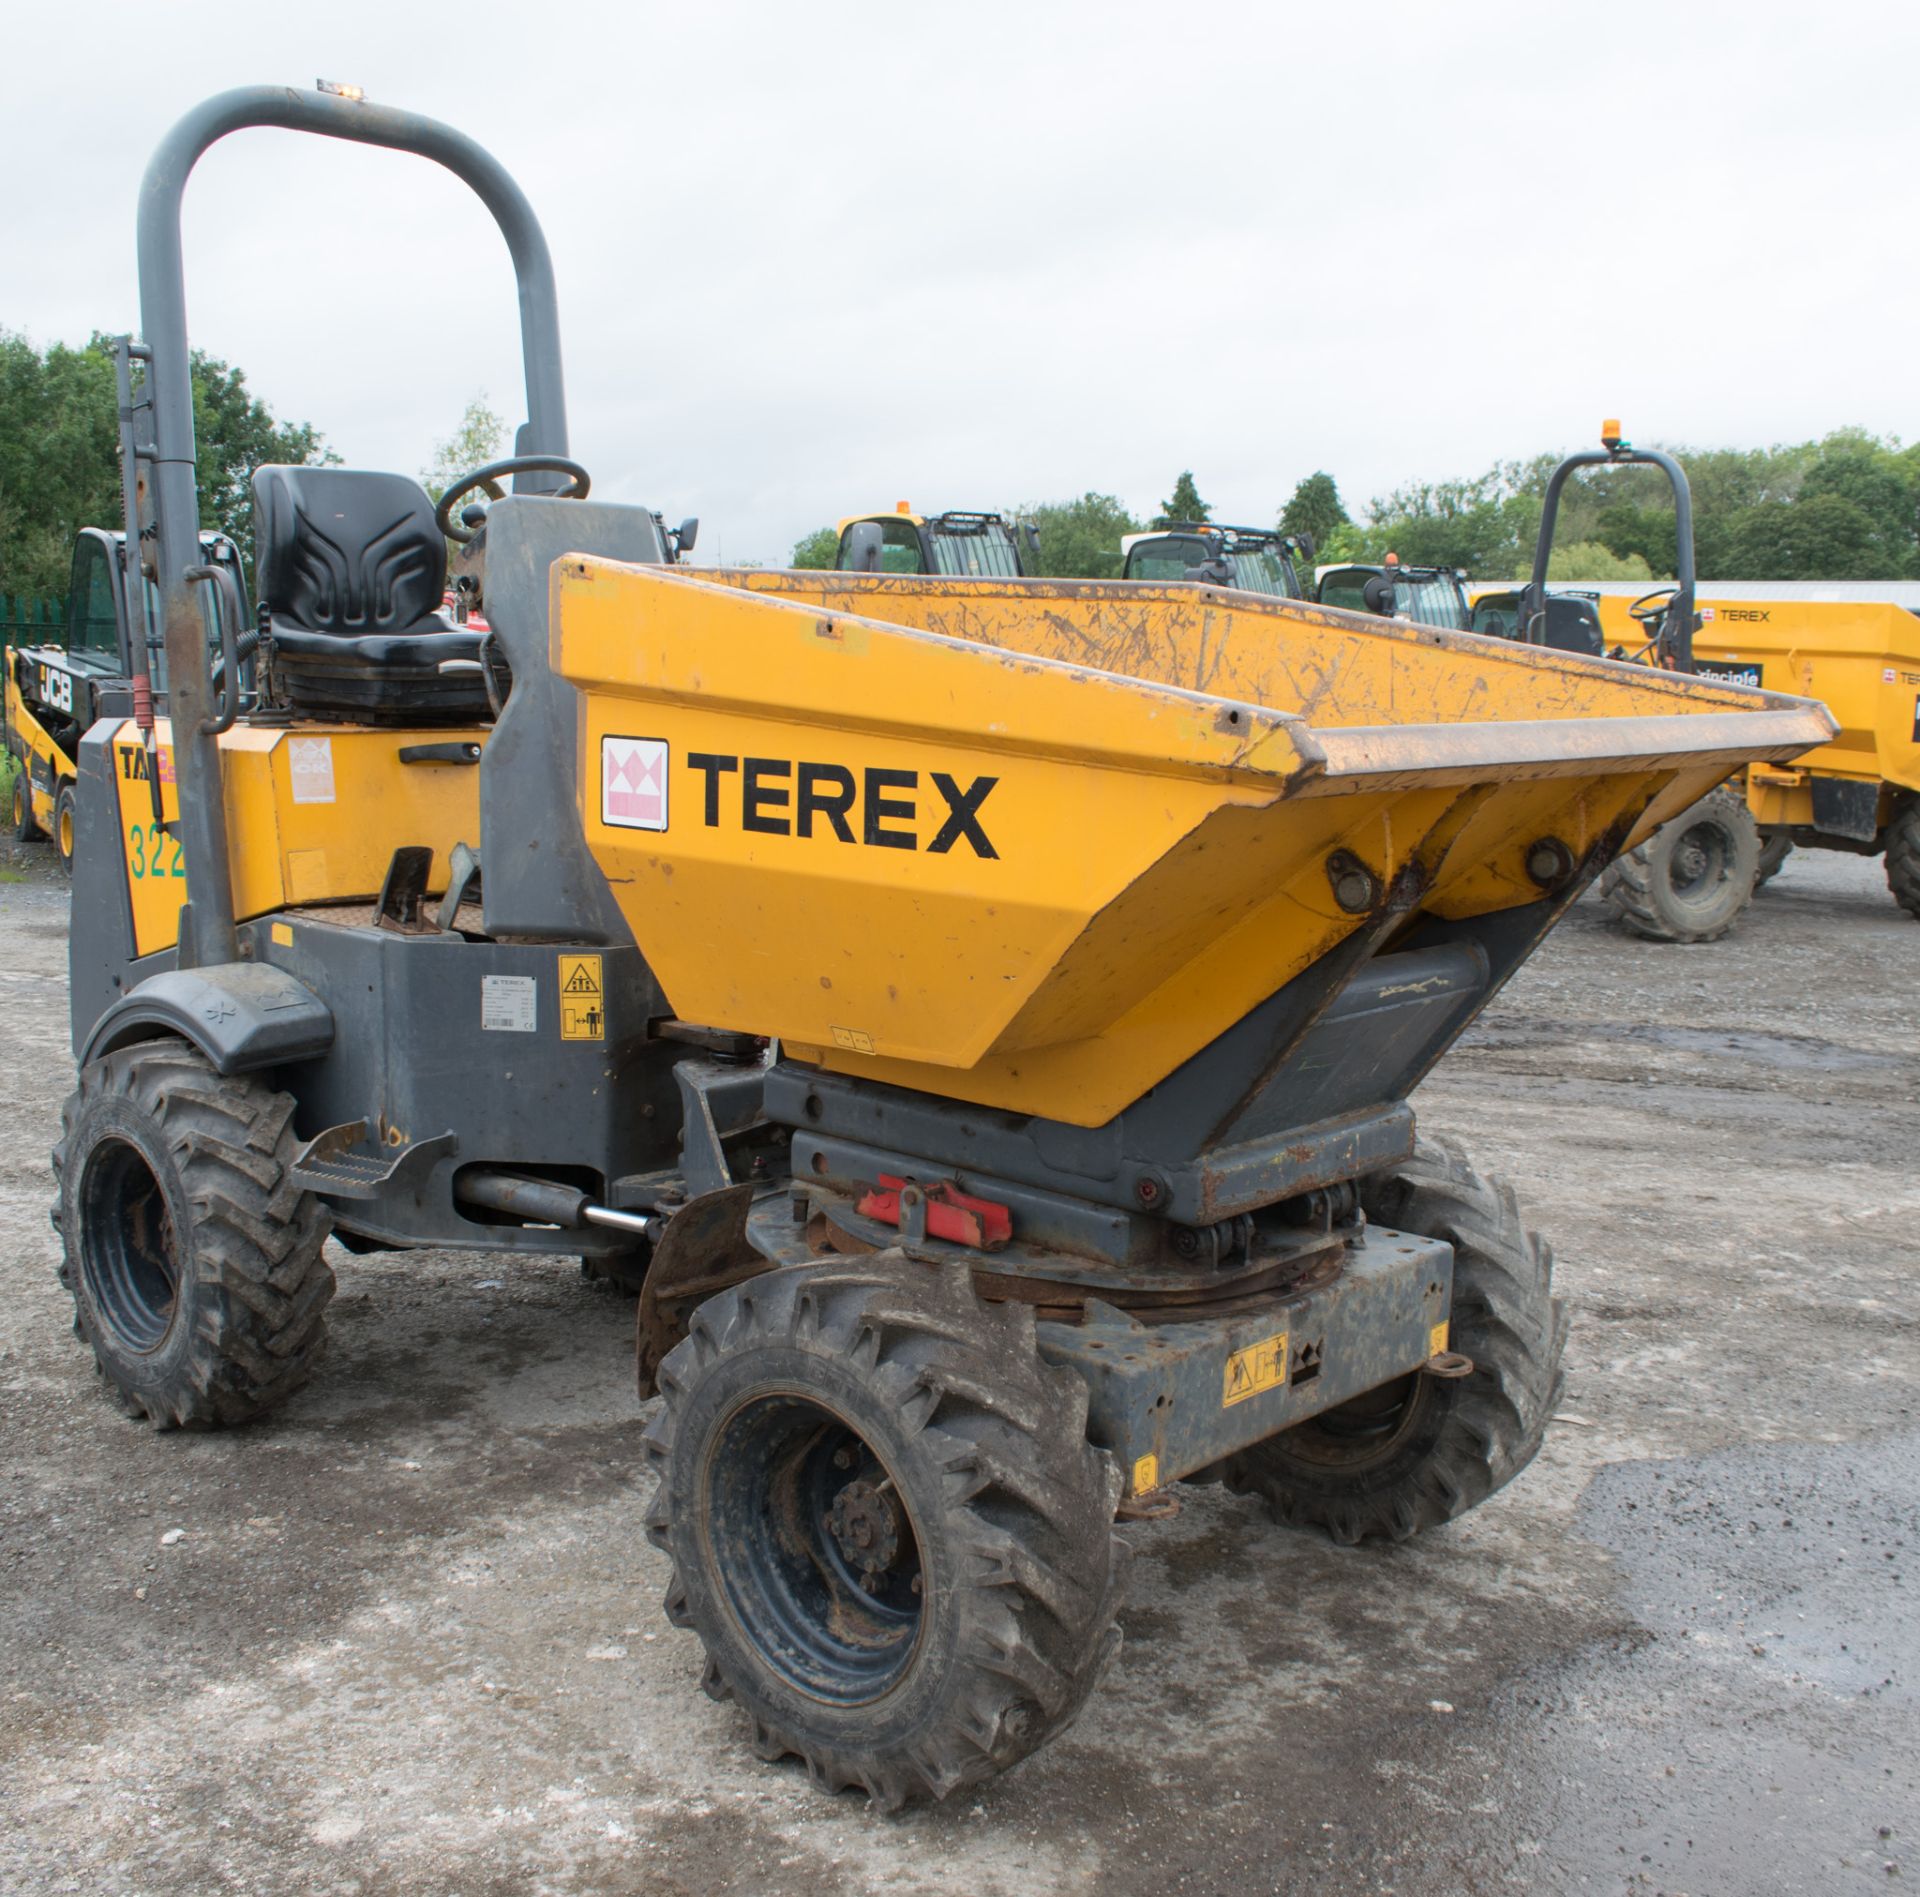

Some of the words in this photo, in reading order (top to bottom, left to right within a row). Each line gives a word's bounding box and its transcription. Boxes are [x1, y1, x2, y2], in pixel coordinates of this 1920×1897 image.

[1720, 609, 1771, 622] TEREX
[40, 667, 72, 713] JCB
[687, 752, 1001, 861] TEREX
